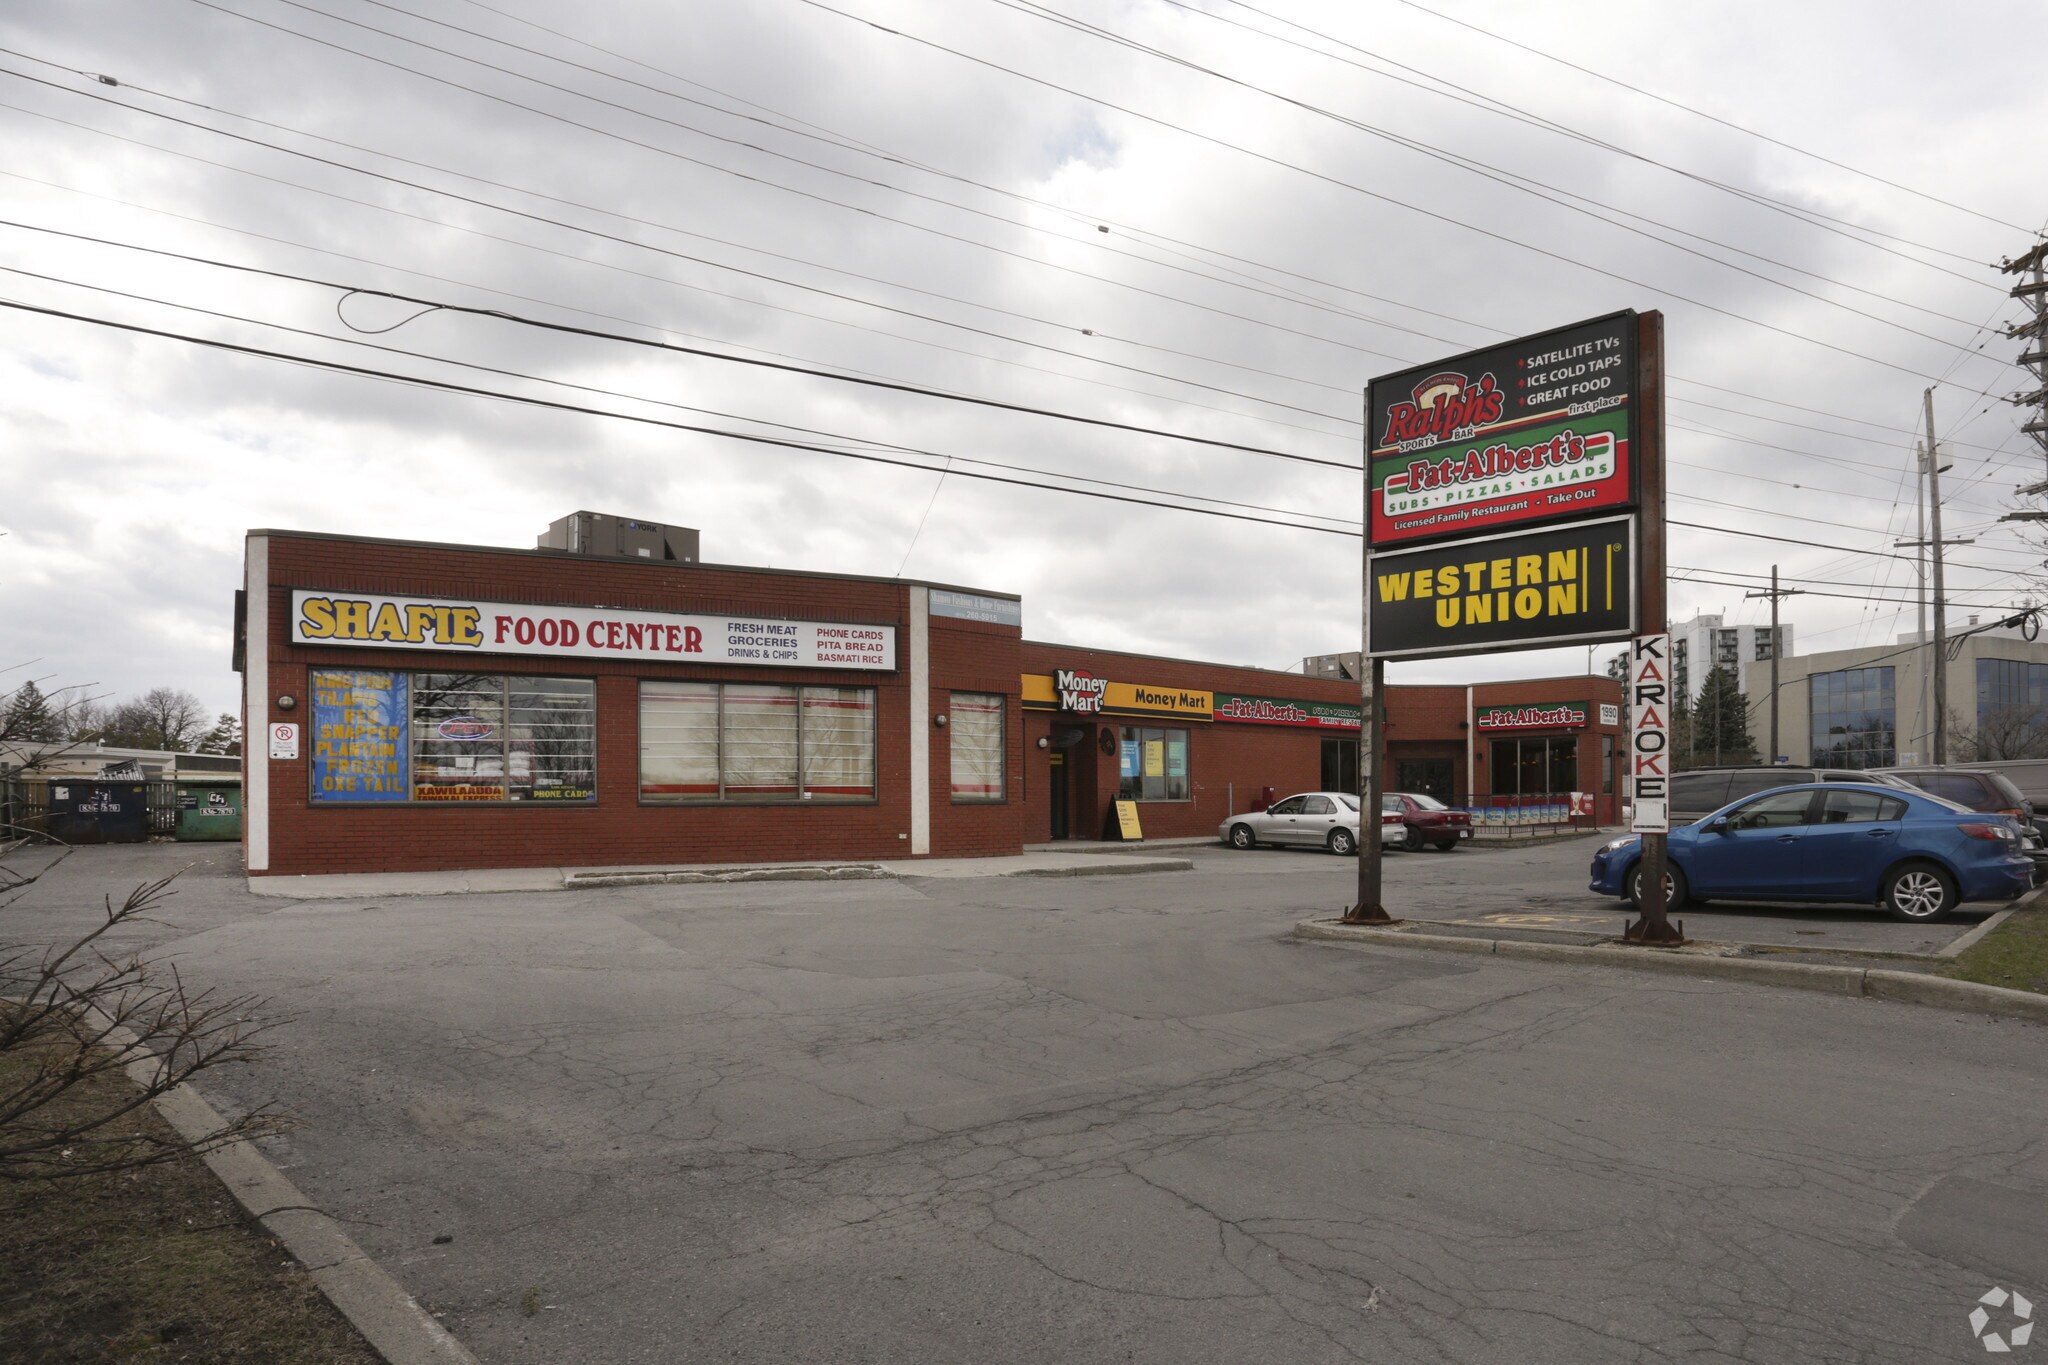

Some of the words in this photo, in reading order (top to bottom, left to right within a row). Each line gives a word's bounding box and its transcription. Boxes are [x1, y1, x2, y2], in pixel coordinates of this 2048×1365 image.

[1527, 342, 1592, 369] SATELLITE
[1595, 337, 1620, 353] TVs
[1528, 372, 1548, 388] ICE
[1550, 365, 1586, 384] COLD
[1588, 354, 1622, 374] TAPS
[1527, 387, 1569, 406] GREAT
[1572, 376, 1610, 396] FOOD
[1381, 373, 1505, 446] Ralph's
[1568, 400, 1590, 415] first
[1592, 396, 1620, 412] place
[1400, 436, 1435, 452] SPORTS
[1454, 428, 1474, 440] BAR
[1389, 497, 1428, 512] SUBS
[1446, 482, 1512, 502] PIZZAS
[1531, 464, 1608, 486] SALADS
[1394, 514, 1436, 530] Licensed
[1437, 508, 1470, 524] Family
[1472, 500, 1528, 517] Restaurant
[1546, 492, 1572, 506] Take
[1574, 488, 1596, 500] Out
[637, 524, 657, 533] YORK
[1378, 549, 1576, 602] WESTERN
[1436, 583, 1576, 628] UNION
[300, 597, 484, 648] SHAFIE
[495, 616, 580, 647] FOOD
[586, 620, 703, 653] CENTER
[728, 622, 764, 634] FRESH
[766, 624, 798, 636] MEAT
[728, 636, 798, 648] GROCERIES
[817, 628, 849, 639] PHONE
[852, 630, 884, 640] CARDS
[728, 648, 760, 659] DRINKS
[763, 650, 770, 659] &
[772, 650, 798, 660] CHIPS
[817, 640, 842, 650] PITA
[845, 642, 884, 652] BREAD
[817, 652, 860, 663] BASMATI
[862, 654, 884, 664] RICE
[1058, 670, 1108, 697] Money
[1062, 691, 1100, 712] Mart
[1136, 688, 1176, 708] Money
[1180, 693, 1204, 708] Mart
[344, 709, 379, 724] RED
[1602, 706, 1616, 718] 1990
[1636, 637, 1666, 798] KARAOKE
[440, 722, 492, 734] OPEN
[1340, 718, 1361, 727] RESTAU
[322, 724, 400, 740] SNAPPER
[317, 742, 395, 758] PLANTAIN
[328, 759, 398, 774] FROZEN
[323, 776, 358, 792] OXE
[364, 777, 405, 792] TAIL
[534, 790, 562, 798] PHONE
